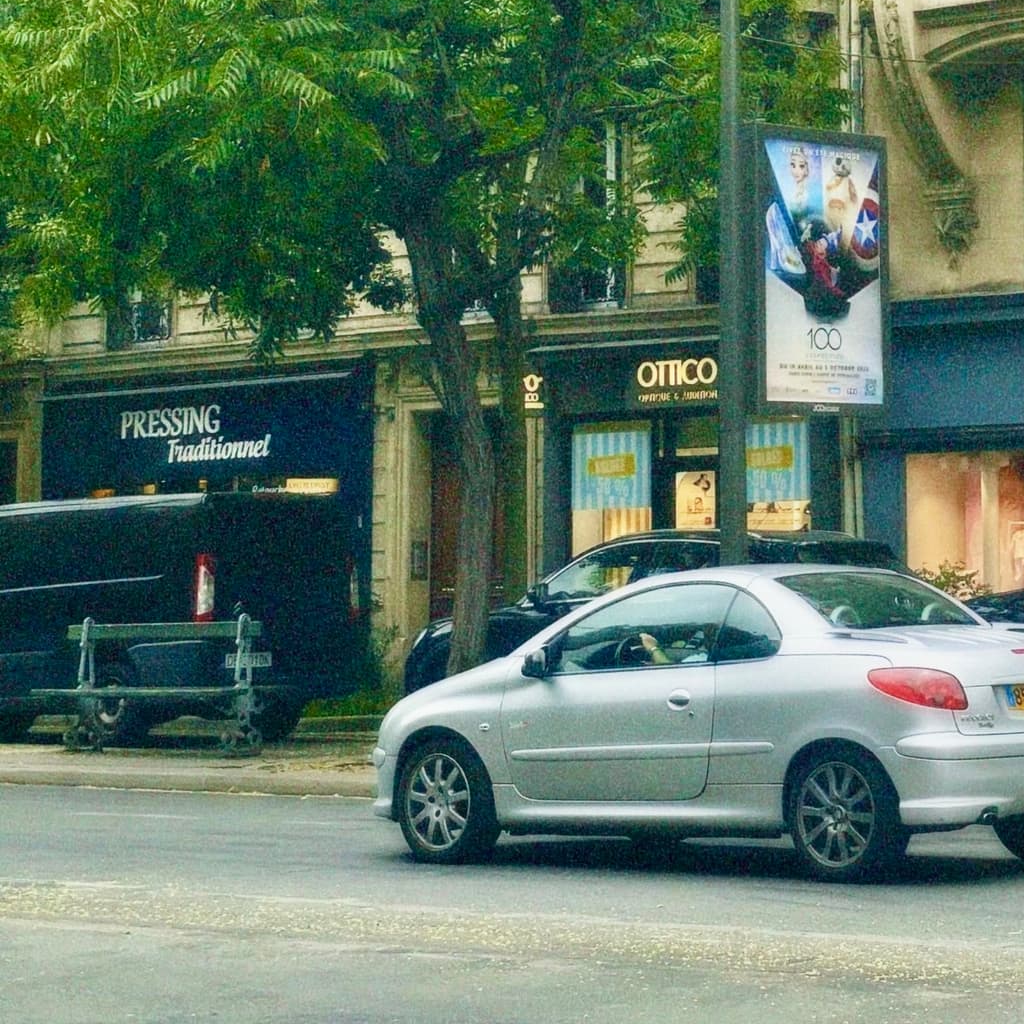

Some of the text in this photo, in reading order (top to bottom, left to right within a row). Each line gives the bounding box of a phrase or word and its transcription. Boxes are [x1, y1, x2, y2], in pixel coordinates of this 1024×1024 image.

[807, 327, 842, 351] 100
[637, 357, 718, 387] OTTICO
[638, 392, 671, 402] OPTIQUE
[682, 390, 718, 401] AUDITION
[121, 405, 221, 440] PRESSING
[167, 434, 271, 464] Traditionnel
